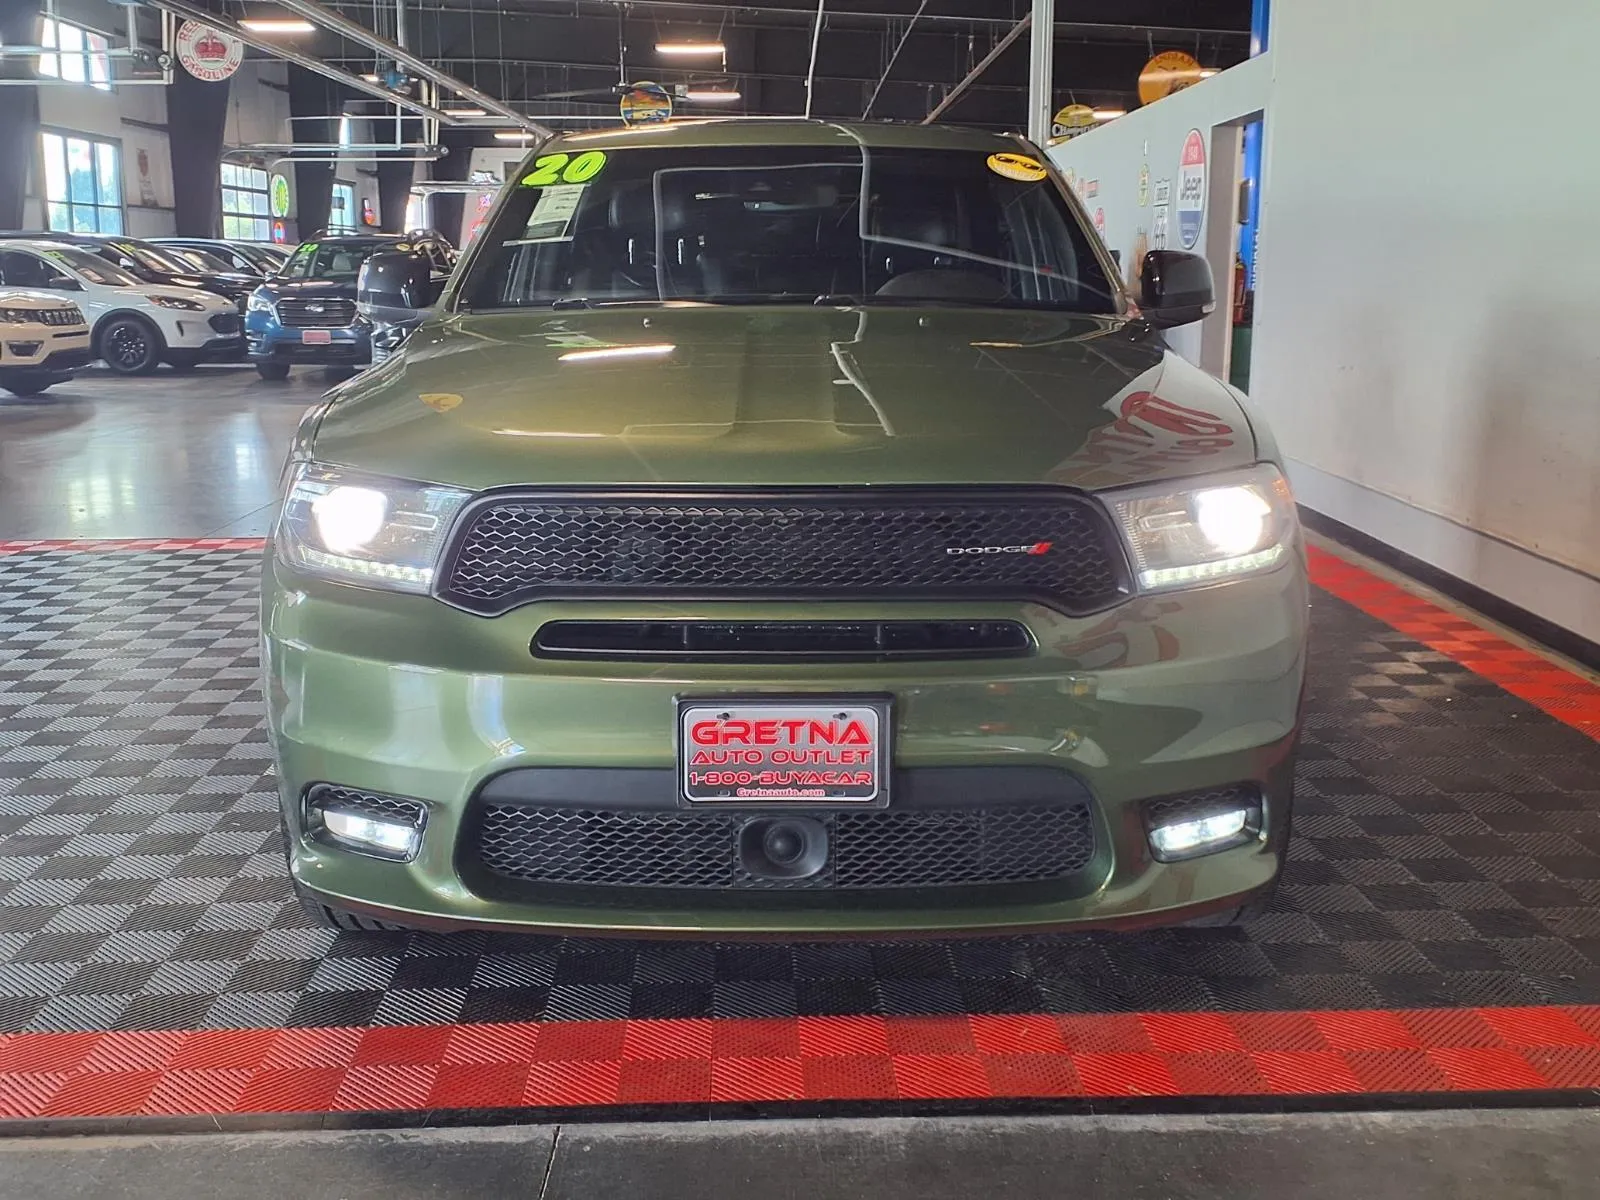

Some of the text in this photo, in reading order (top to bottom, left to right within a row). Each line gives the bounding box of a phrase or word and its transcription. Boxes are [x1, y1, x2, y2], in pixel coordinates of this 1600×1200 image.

[182, 55, 239, 80] GASOLINE
[521, 151, 607, 187] 20
[946, 545, 1035, 555] DODGE
[690, 720, 871, 746] GRETNA
[690, 749, 873, 765] AUTO OUTLET
[689, 771, 872, 785] 1-800-BUYACAR
